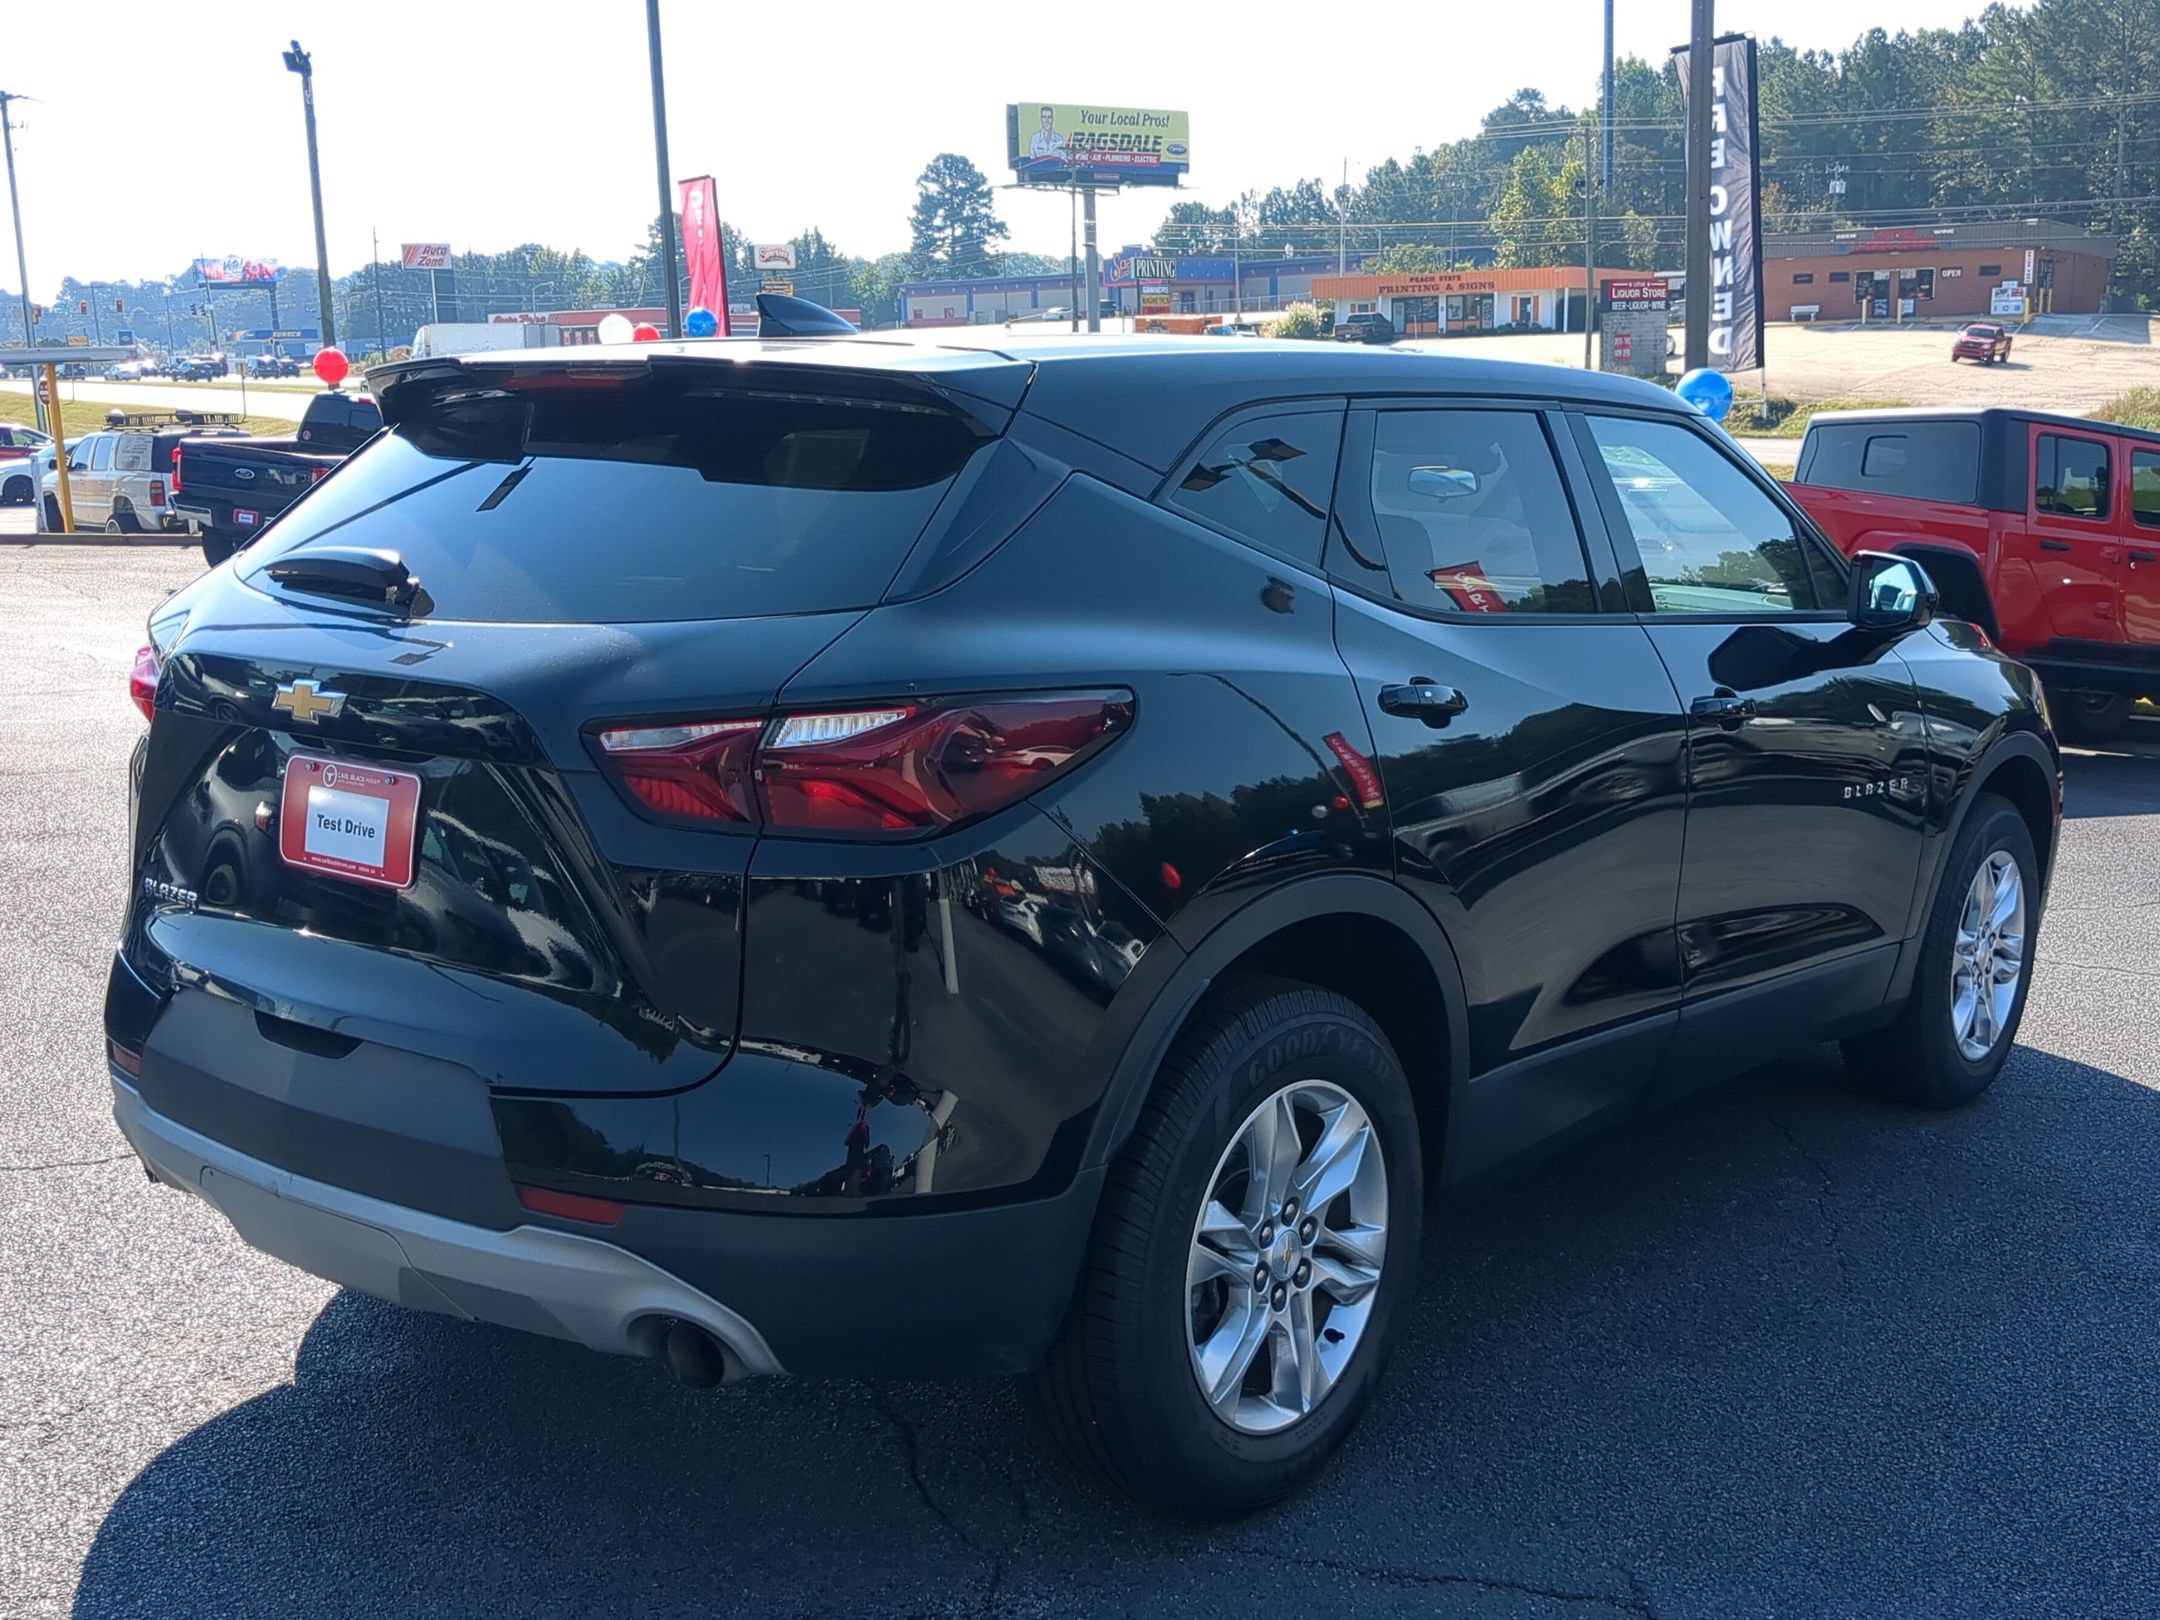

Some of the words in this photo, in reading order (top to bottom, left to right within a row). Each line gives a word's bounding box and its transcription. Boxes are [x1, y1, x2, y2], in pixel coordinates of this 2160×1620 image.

[1080, 109, 1108, 125] Your
[1109, 111, 1140, 127] Local
[1141, 113, 1170, 128] Pros!
[1072, 131, 1163, 153] RAGSDALE
[422, 245, 447, 256] Auto
[417, 256, 445, 267] Zone
[1136, 258, 1175, 278] PRINTING
[1379, 284, 1440, 294] PRINTING
[1446, 283, 1454, 291] &
[1458, 281, 1495, 290] SIGNS
[1612, 287, 1640, 299] LIQUOR
[1642, 287, 1667, 299] STORE
[1843, 777, 1908, 799] BLAZER
[317, 814, 342, 833] Test
[345, 819, 375, 838] Drive
[144, 877, 198, 909] BLAZER
